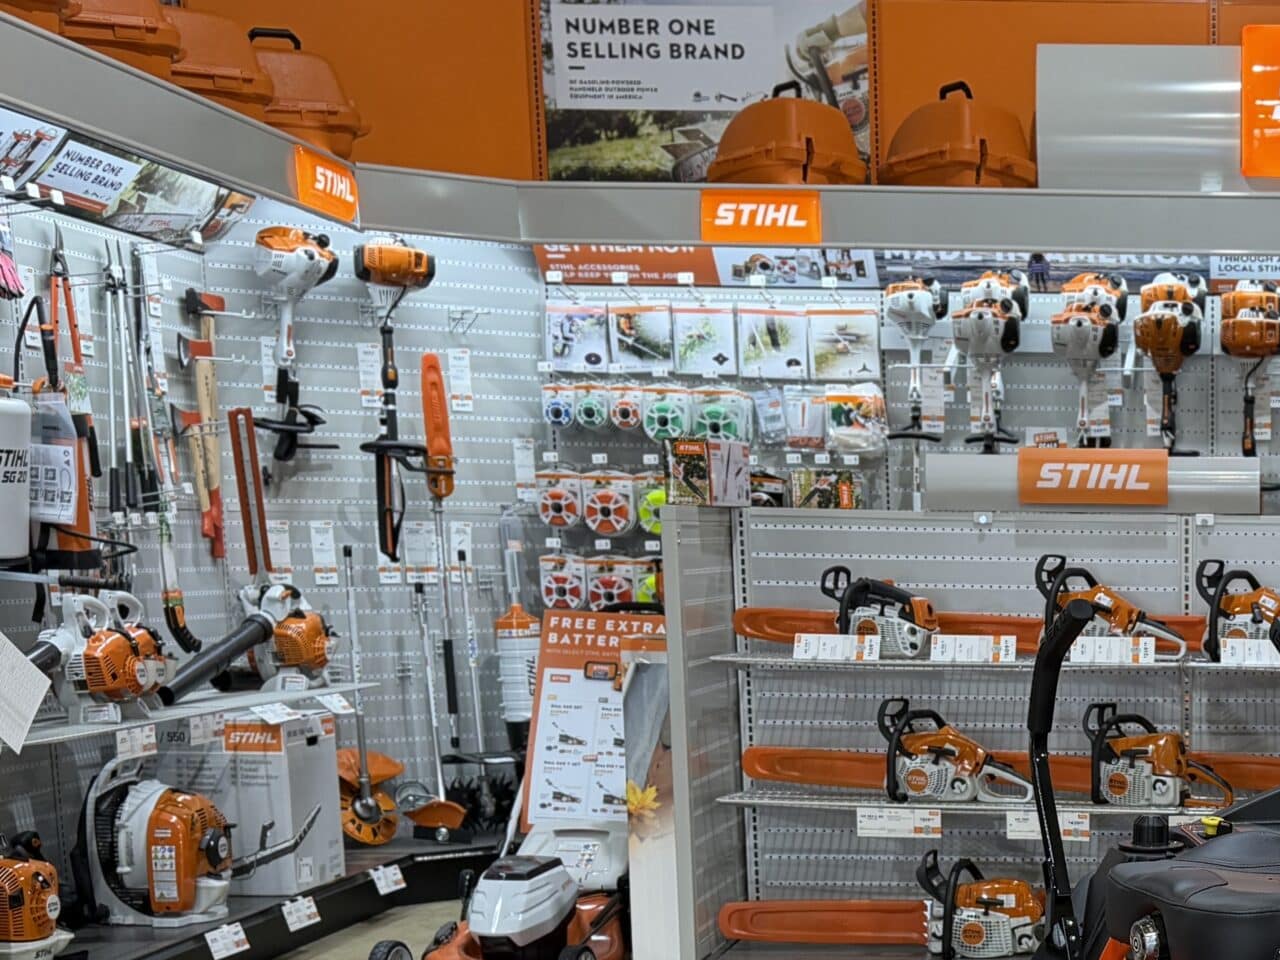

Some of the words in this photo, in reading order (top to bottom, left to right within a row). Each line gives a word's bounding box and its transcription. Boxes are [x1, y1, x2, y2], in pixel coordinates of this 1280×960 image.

[565, 18, 660, 35] NUMBER
[668, 19, 715, 36] ONE
[566, 42, 661, 59] SELLING
[669, 43, 745, 60] BRAND
[62, 149, 102, 170] NUMBER
[102, 163, 124, 177] ONE
[52, 162, 92, 182] SELLING
[91, 174, 122, 191] BRAND
[314, 166, 354, 202] STIHL
[714, 203, 808, 227] STIHL
[1217, 255, 1274, 263] THROUGH
[1218, 265, 1255, 273] LOCAL
[0, 449, 28, 468] TIHL
[2, 471, 17, 483] SG
[1036, 463, 1150, 490] STIHL
[550, 616, 596, 630] FREE
[605, 620, 666, 634] EXTRA
[548, 632, 620, 647] BATTER
[229, 732, 277, 744] STIHL
